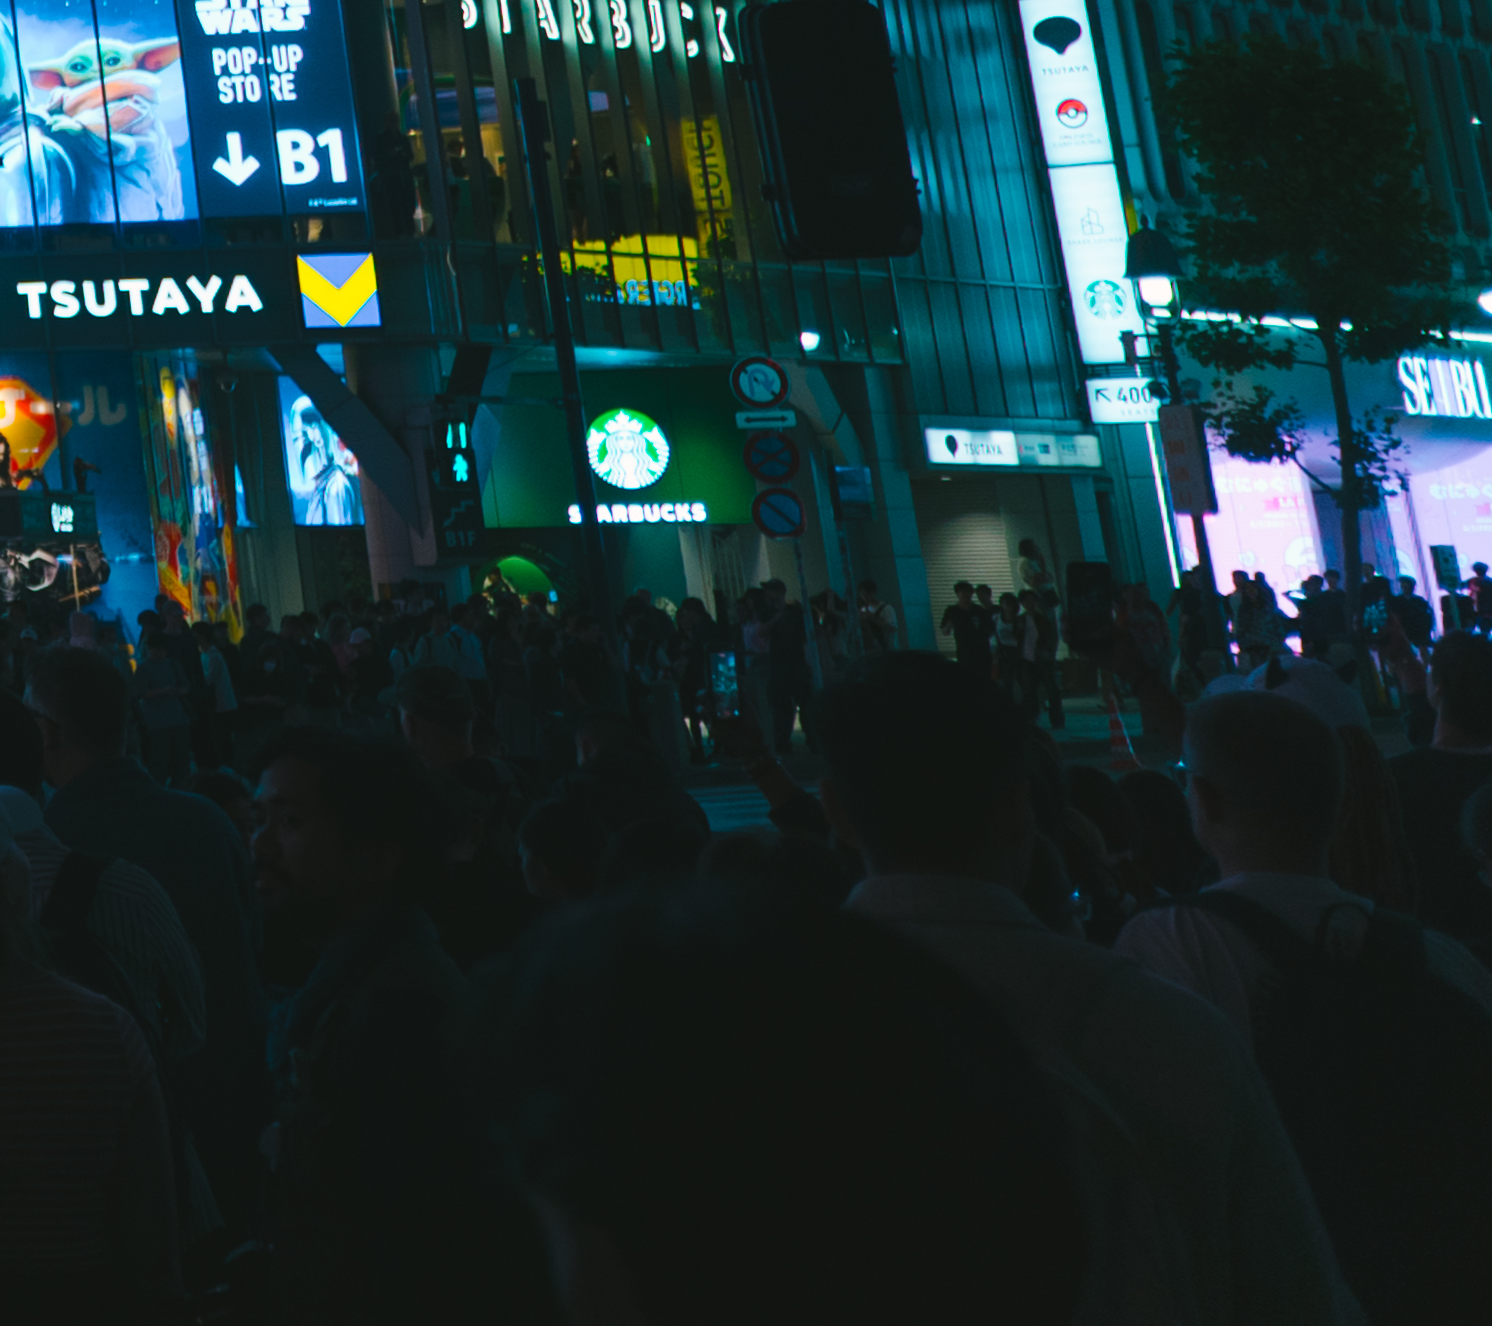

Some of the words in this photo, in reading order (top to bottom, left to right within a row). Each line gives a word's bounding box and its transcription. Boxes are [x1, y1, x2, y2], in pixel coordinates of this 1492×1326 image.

[195, 5, 311, 36] WARS
[217, 73, 298, 104] STORE
[276, 127, 348, 186] B1
[16, 273, 263, 320] TSUTAYA
[567, 502, 708, 525] SARBUCKS
